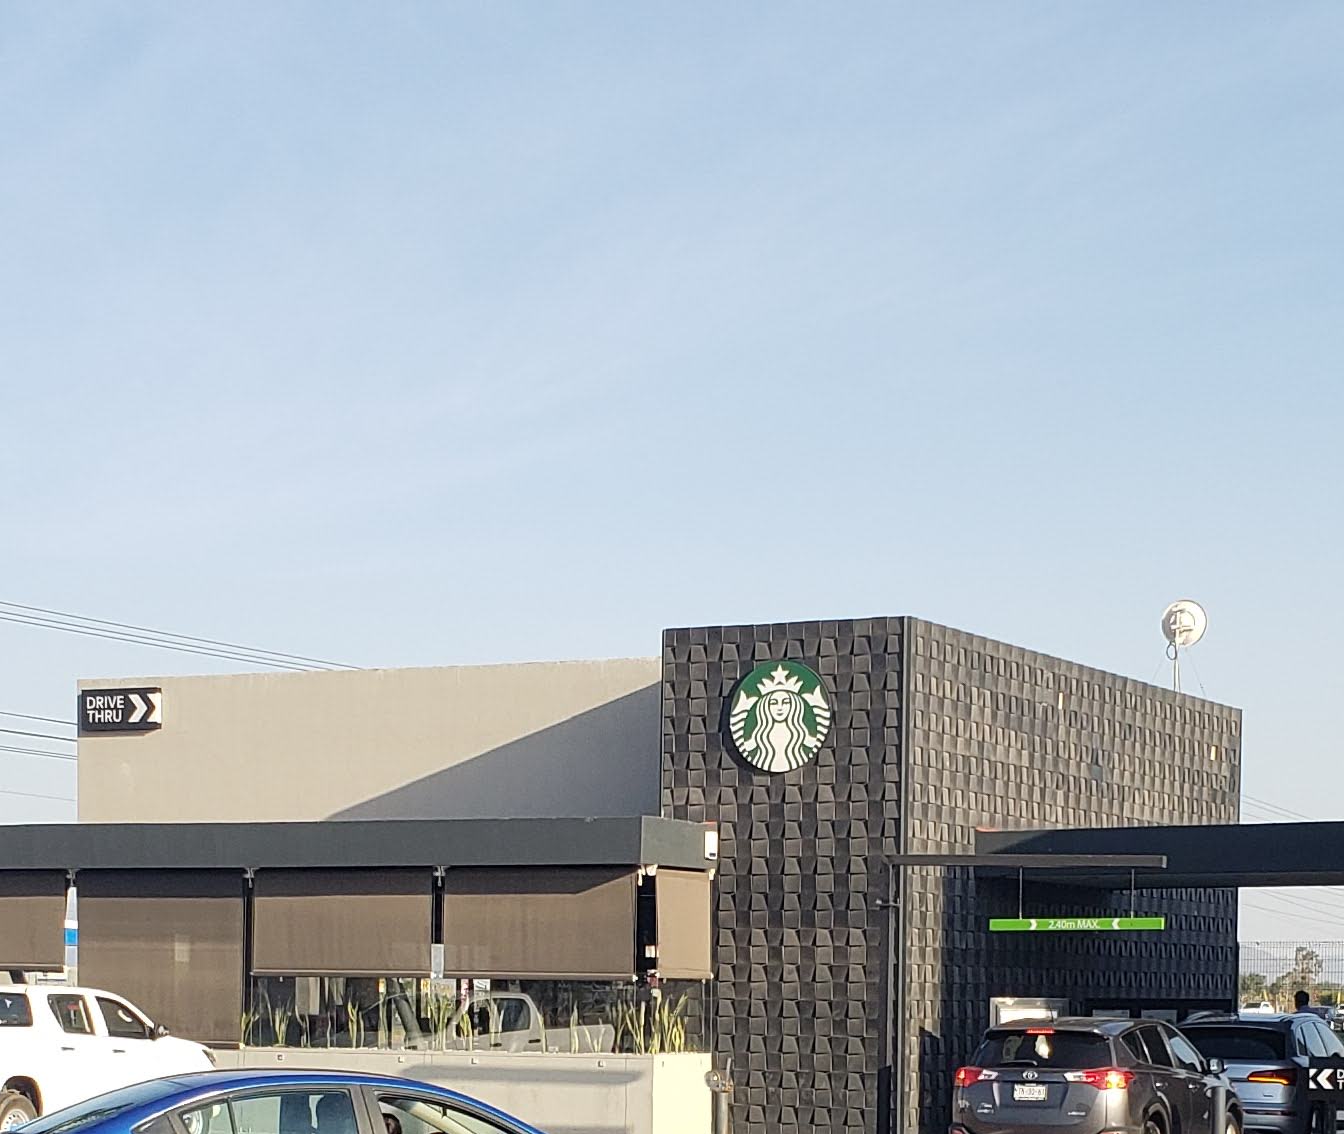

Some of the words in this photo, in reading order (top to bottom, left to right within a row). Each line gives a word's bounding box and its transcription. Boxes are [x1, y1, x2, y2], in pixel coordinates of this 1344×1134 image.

[86, 695, 125, 709] DRIVE
[87, 709, 123, 723] THRU
[1048, 919, 1076, 930] 2.40m
